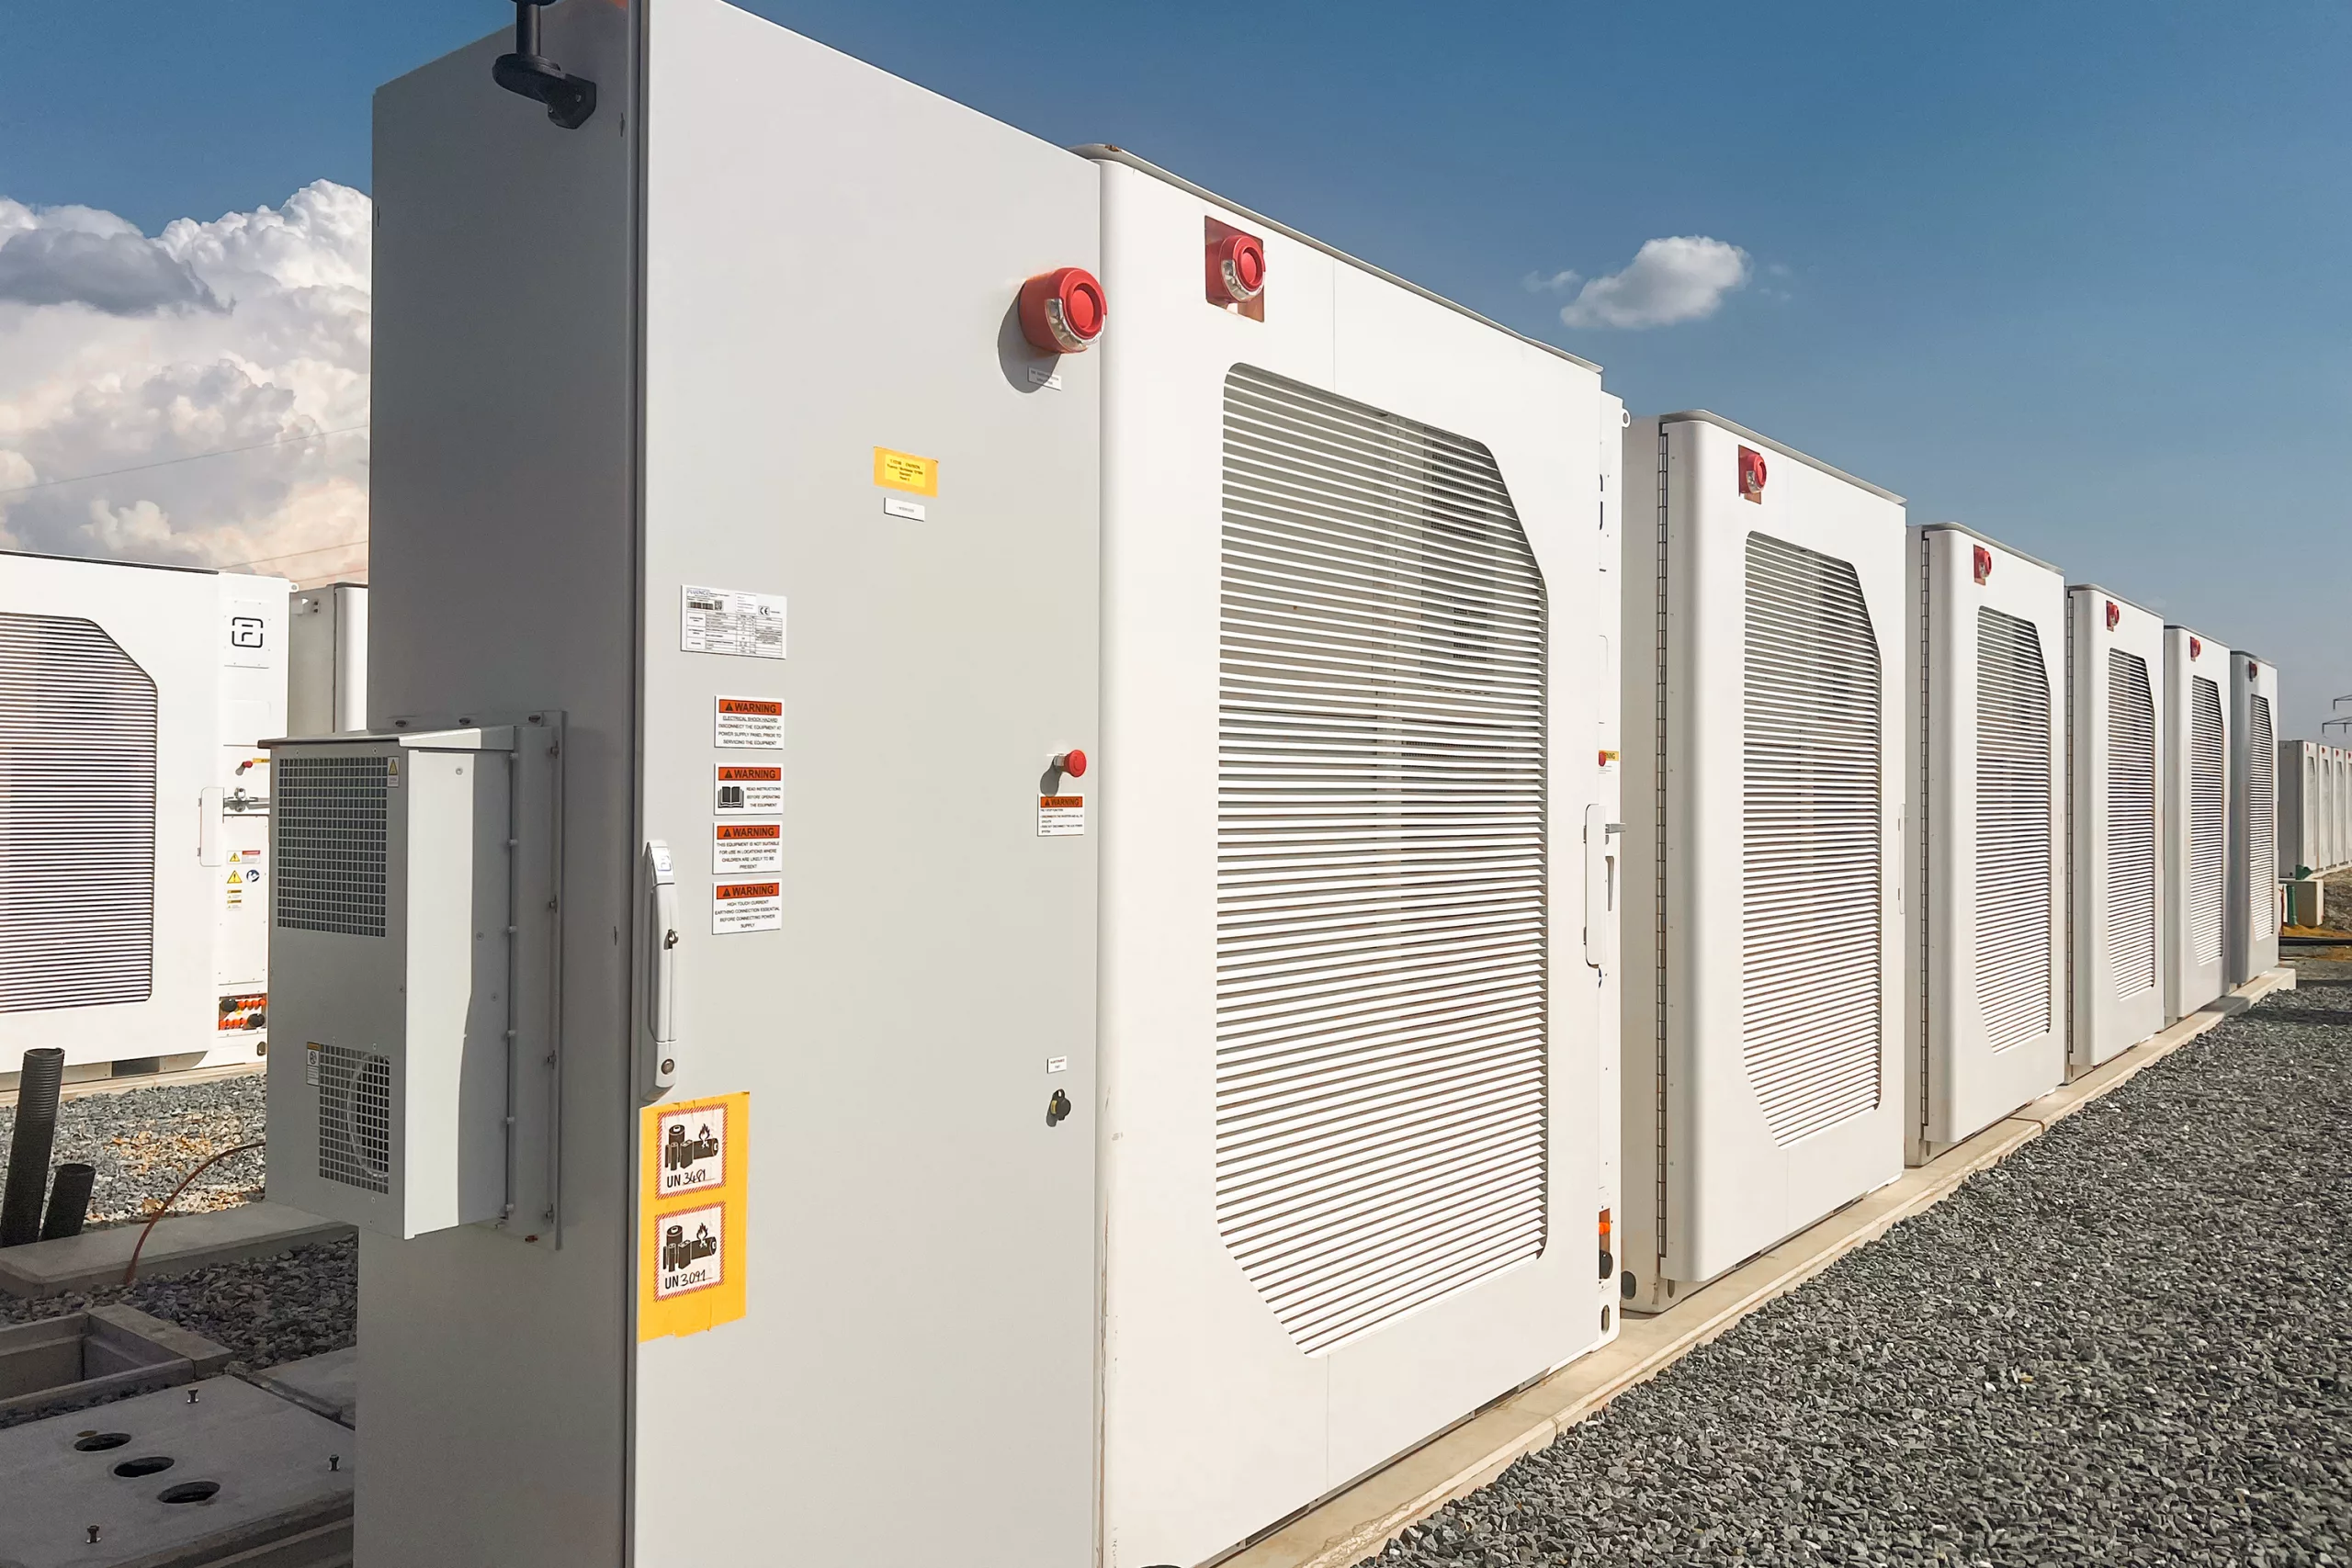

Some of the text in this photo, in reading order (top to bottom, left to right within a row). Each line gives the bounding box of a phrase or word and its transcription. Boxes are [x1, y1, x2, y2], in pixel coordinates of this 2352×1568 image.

[735, 703, 776, 713] WARNING
[734, 770, 775, 778] WARNING
[733, 828, 774, 836] WARNING
[732, 885, 773, 896] WARNING
[667, 1169, 706, 1188] UN 3481
[665, 1269, 706, 1289] UN 3091
